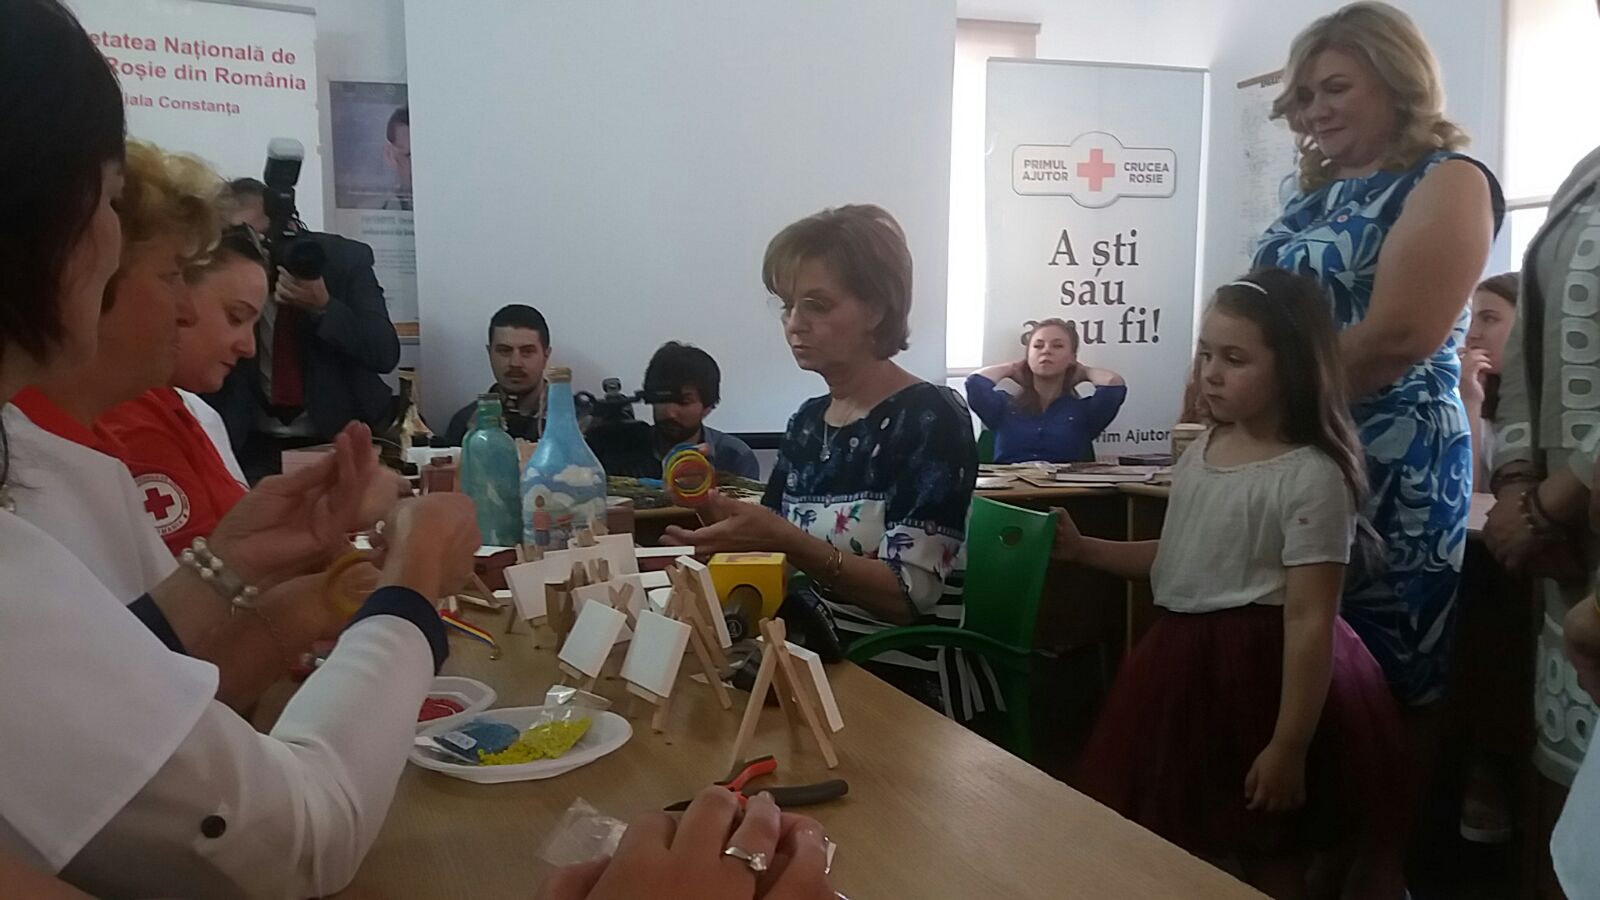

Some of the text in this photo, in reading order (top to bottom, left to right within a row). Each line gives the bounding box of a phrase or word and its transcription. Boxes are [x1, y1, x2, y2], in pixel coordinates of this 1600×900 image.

[164, 36, 265, 62] Națională
[271, 48, 296, 65] de
[174, 64, 207, 82] din
[215, 67, 306, 91] România
[158, 95, 241, 115] Constanța
[1023, 159, 1067, 170] PRIMUL
[1123, 162, 1169, 173] CRUCEA
[1021, 171, 1069, 182] AJUTOR
[1047, 229, 1140, 277] A ști
[1118, 306, 1161, 344] fi!
[1125, 429, 1171, 445] Ajutor
